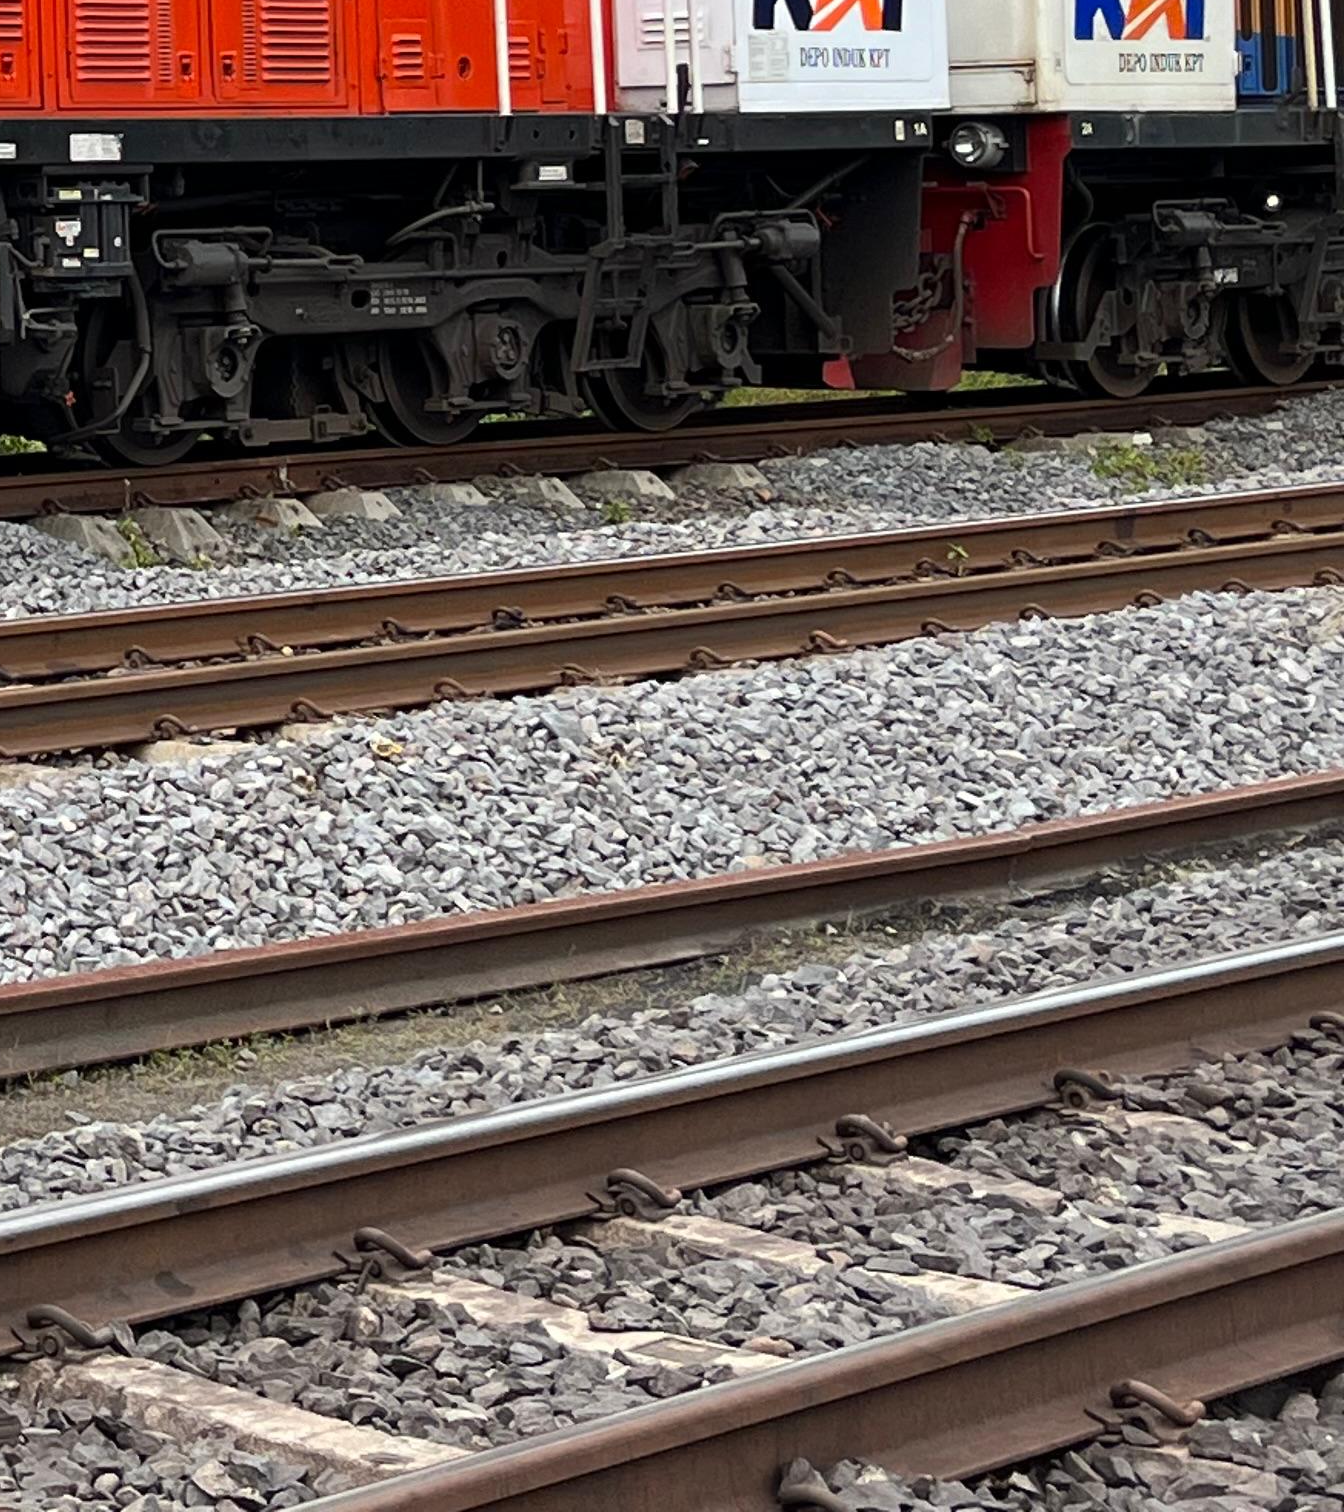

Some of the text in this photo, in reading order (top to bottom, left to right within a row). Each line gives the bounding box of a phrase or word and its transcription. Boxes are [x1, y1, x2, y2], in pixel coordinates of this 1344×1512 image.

[800, 47, 829, 67] DEPO
[832, 47, 867, 68] INDUK
[869, 48, 891, 68] KPT
[1118, 52, 1147, 73] DEPO
[913, 121, 928, 136] 1A
